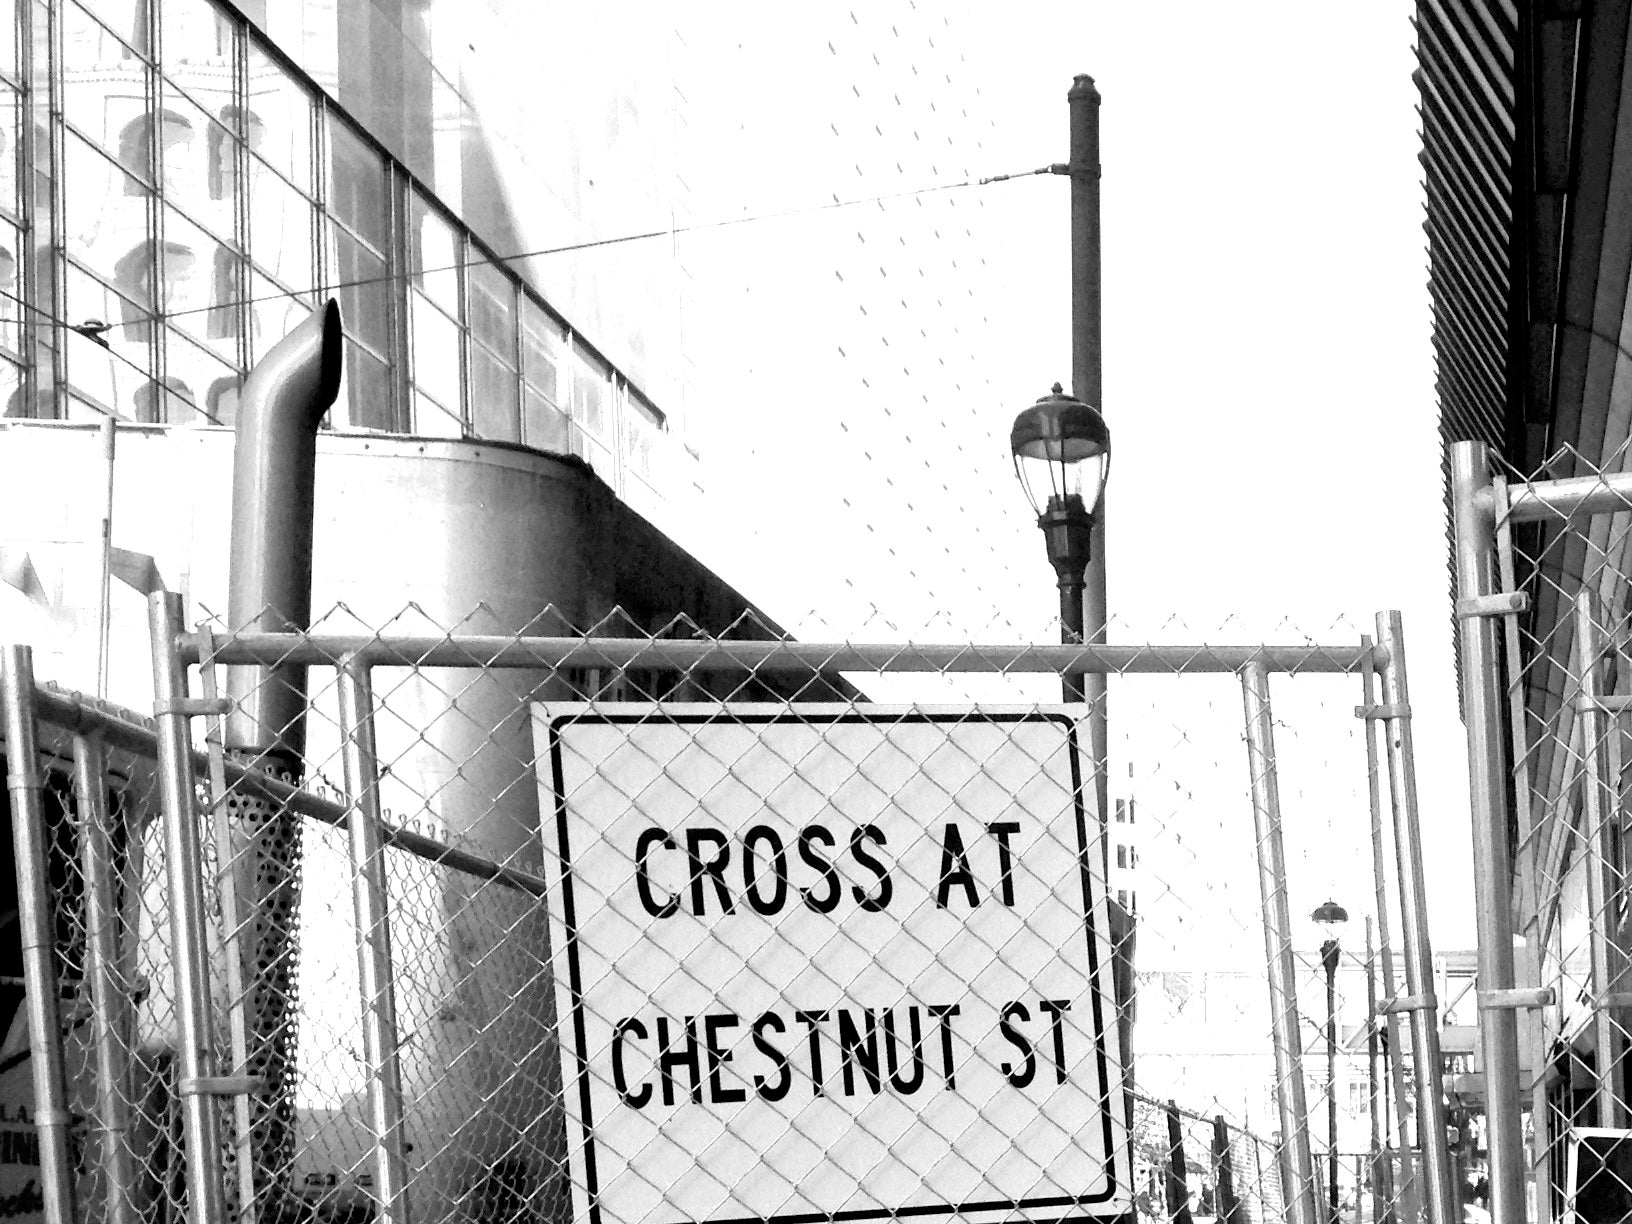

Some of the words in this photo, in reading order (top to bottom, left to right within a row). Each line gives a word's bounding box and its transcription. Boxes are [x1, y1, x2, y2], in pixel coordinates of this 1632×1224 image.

[635, 823, 893, 919] CROSS
[936, 821, 1021, 909] AT
[610, 1003, 960, 1110] CHESTNUT
[999, 999, 1072, 1089] ST
